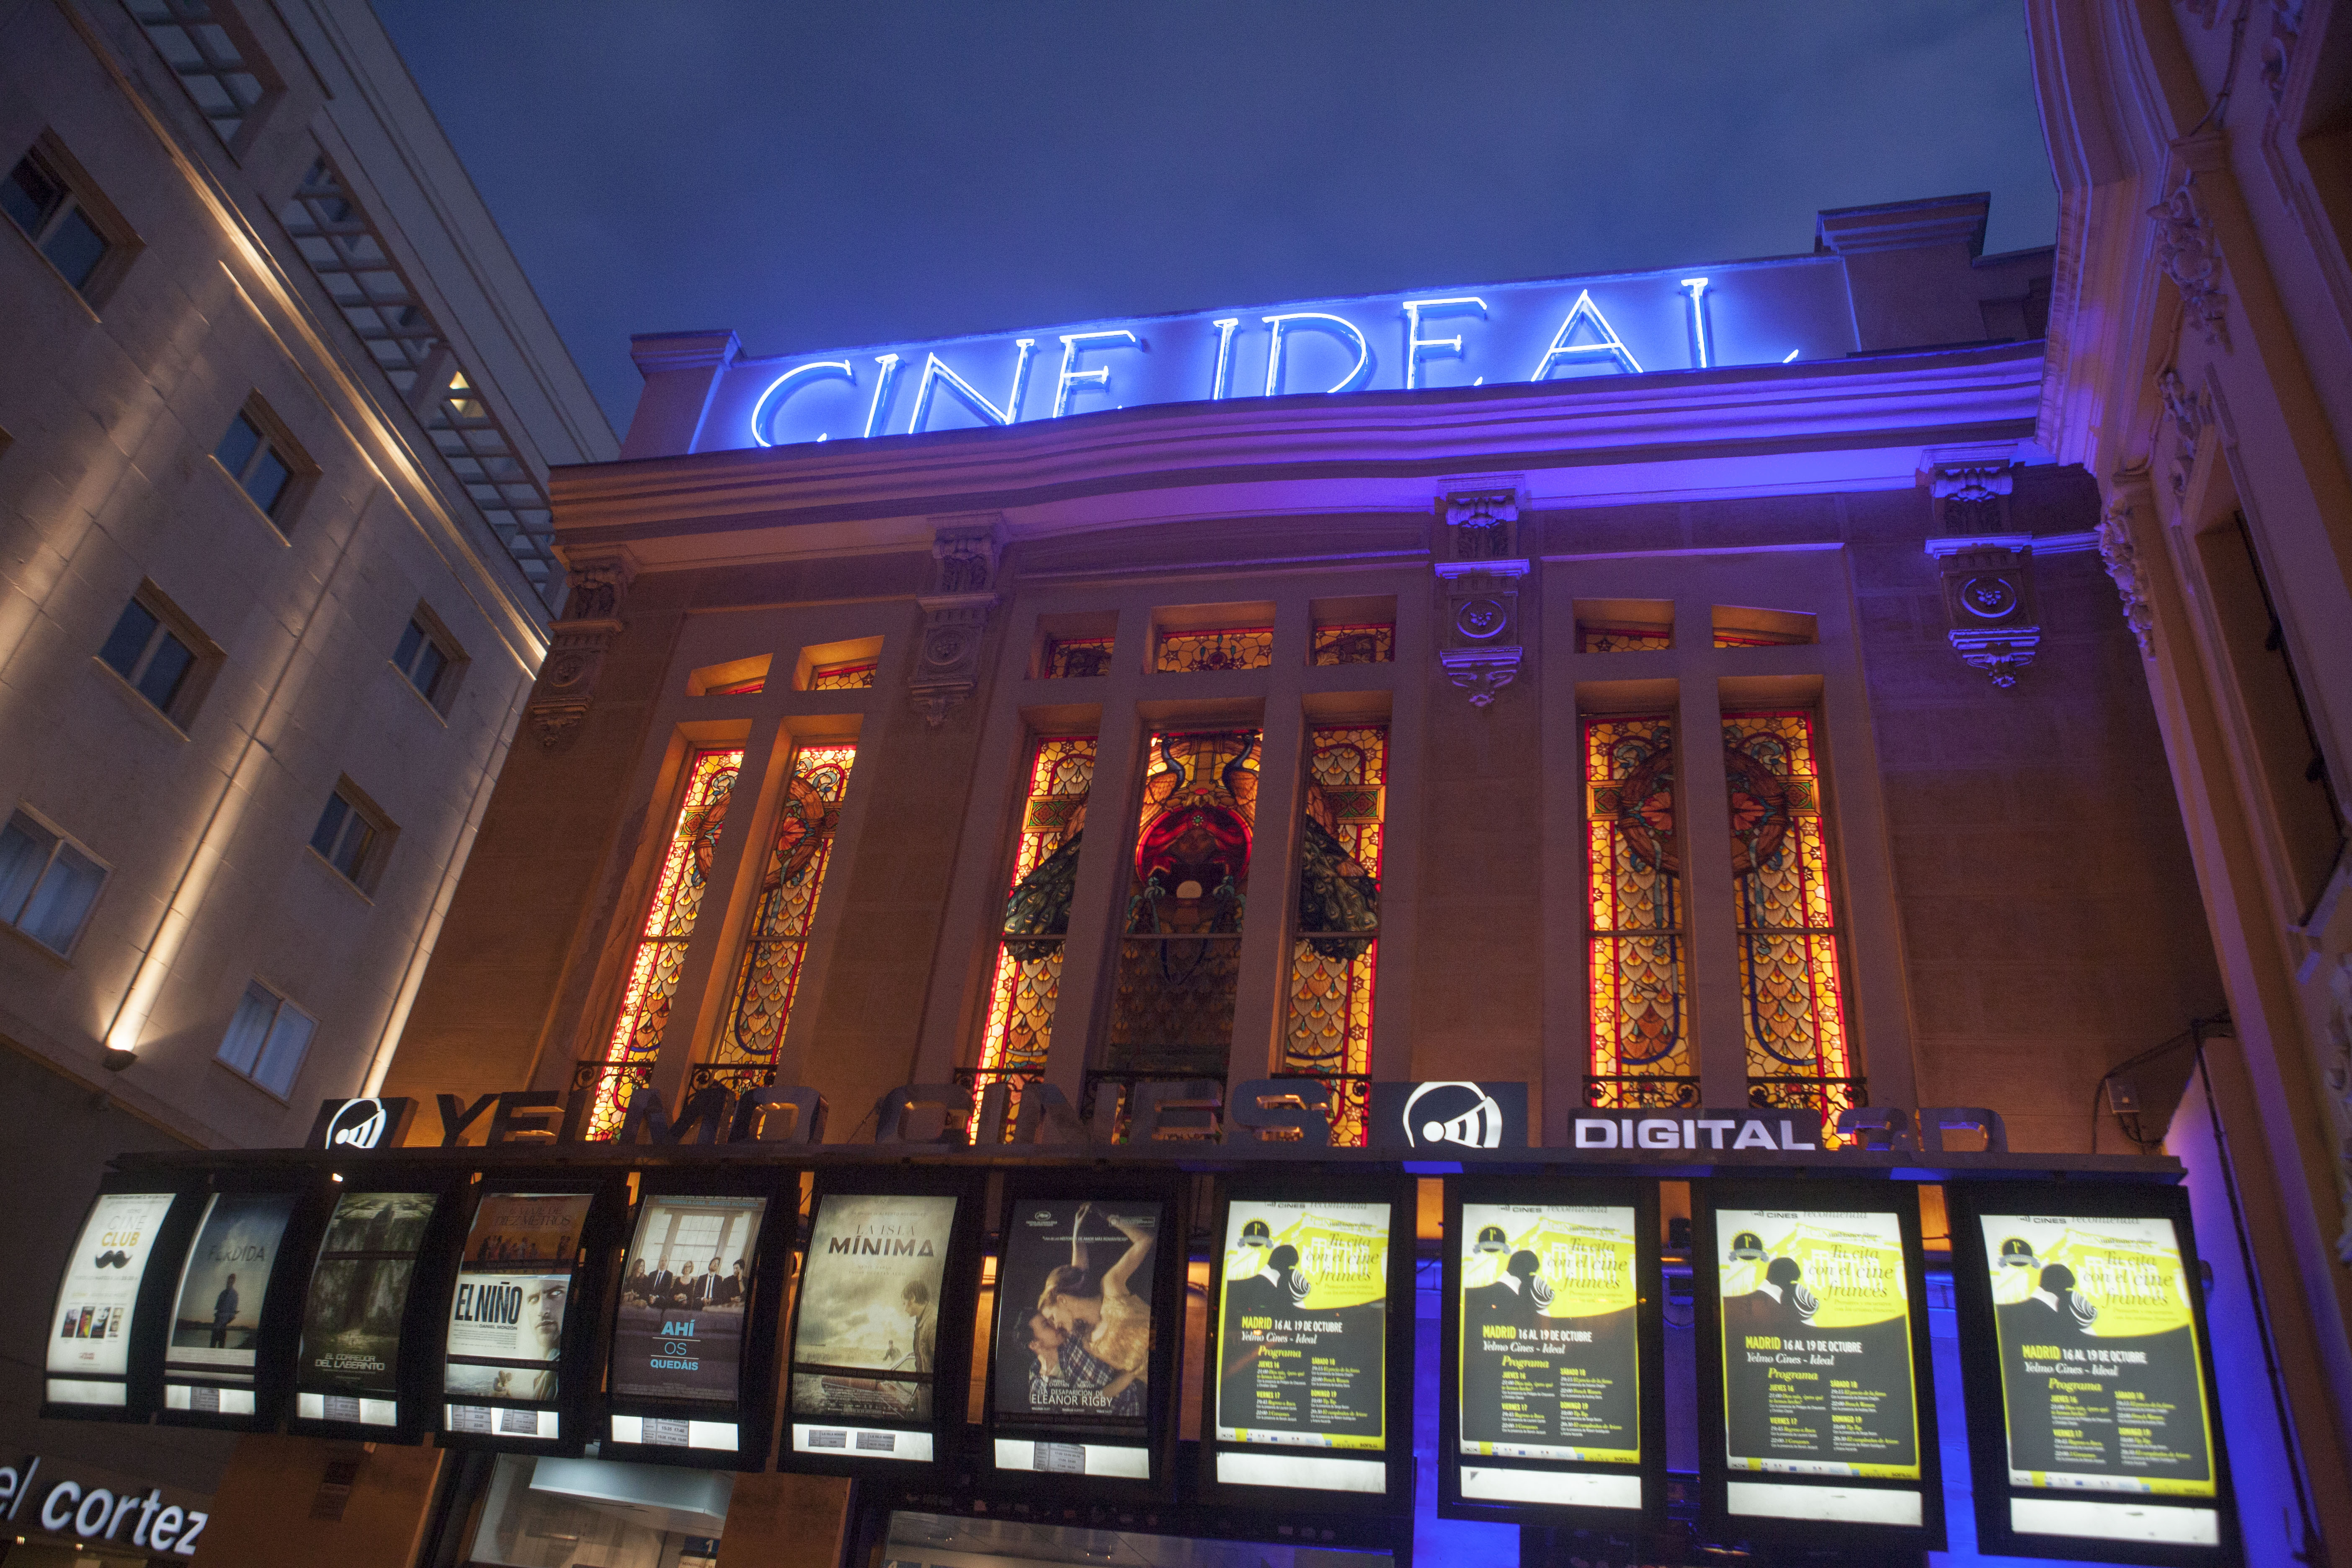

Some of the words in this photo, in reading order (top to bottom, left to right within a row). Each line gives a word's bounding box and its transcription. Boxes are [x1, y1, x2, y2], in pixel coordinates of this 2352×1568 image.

[751, 328, 1143, 449] CINE
[1213, 277, 1800, 401] IDEAL
[1575, 1118, 1816, 1150] DIGITAL
[856, 1224, 873, 1235] LA
[881, 1225, 915, 1236] ISLA
[101, 1231, 141, 1247] CLUB
[828, 1235, 934, 1257] MÍNIMA
[1346, 1234, 1372, 1247] cita
[1589, 1238, 1615, 1252] cita
[1306, 1253, 1328, 1261] con
[1332, 1249, 1344, 1262] el
[1347, 1249, 1382, 1265] cine
[1830, 1244, 1846, 1258] Tu
[1851, 1245, 1879, 1259] cita
[1547, 1259, 1570, 1267] con
[1576, 1254, 1587, 1268] el
[1592, 1254, 1627, 1271] cine
[1808, 1266, 1833, 1275] con
[1838, 1262, 1851, 1275] el
[1855, 1261, 1894, 1279] cine
[1315, 1265, 1372, 1287] francés
[1559, 1271, 1619, 1294] francés
[2131, 1268, 2174, 1287] cine
[1822, 1279, 1888, 1302] francés
[454, 1283, 475, 1321] EL
[474, 1281, 523, 1325] NIÑO
[661, 1319, 695, 1336] AHÍ
[1241, 1315, 1273, 1330] MADRID
[1274, 1319, 1283, 1330] 16
[1283, 1320, 1293, 1331] AL
[1295, 1320, 1303, 1331] 19
[1303, 1321, 1313, 1331] DE
[1313, 1321, 1343, 1333] OCTUBRE
[1266, 1332, 1289, 1343] Cines
[1295, 1333, 1318, 1344] Ideal
[1483, 1325, 1516, 1339] MADRID
[1519, 1328, 1527, 1339] 16
[1528, 1328, 1538, 1340] AL
[1540, 1329, 1549, 1340] 19
[1550, 1330, 1560, 1341] DE
[1560, 1330, 1592, 1342] OCTUBRE
[664, 1341, 687, 1355] OS
[1510, 1341, 1534, 1353] Cines
[1542, 1342, 1565, 1354] Ideal
[1745, 1335, 1781, 1350] MADRID
[1783, 1338, 1793, 1350] 16
[1794, 1339, 1805, 1351] AL
[1806, 1340, 1816, 1351] 19
[1816, 1340, 1828, 1351] DE
[1828, 1341, 1862, 1353] OCTUBRE
[1258, 1345, 1302, 1361] Programa
[1746, 1351, 1774, 1363] Yelmo
[1775, 1353, 1802, 1364] Cines
[1809, 1353, 1835, 1366] Ideal
[2022, 1344, 2061, 1360] MADRID
[2062, 1348, 2074, 1360] 16
[2073, 1349, 2086, 1361] AL
[2086, 1349, 2098, 1361] 19
[2097, 1349, 2110, 1362] DE
[2109, 1350, 2147, 1364] OCTUBRE
[315, 1359, 332, 1367] DEL
[333, 1360, 386, 1371] LABERINTO
[650, 1359, 699, 1371] QUEDÁIS
[1502, 1355, 1549, 1371] Programa
[1767, 1367, 1818, 1383] Programa
[1051, 1388, 1093, 1397] DESAPARICIÓN
[2048, 1377, 2102, 1395] Programa
[1032, 1394, 1078, 1406] ELEANOR
[1081, 1396, 1113, 1407] RIGBY
[41, 1480, 209, 1555] cortez
